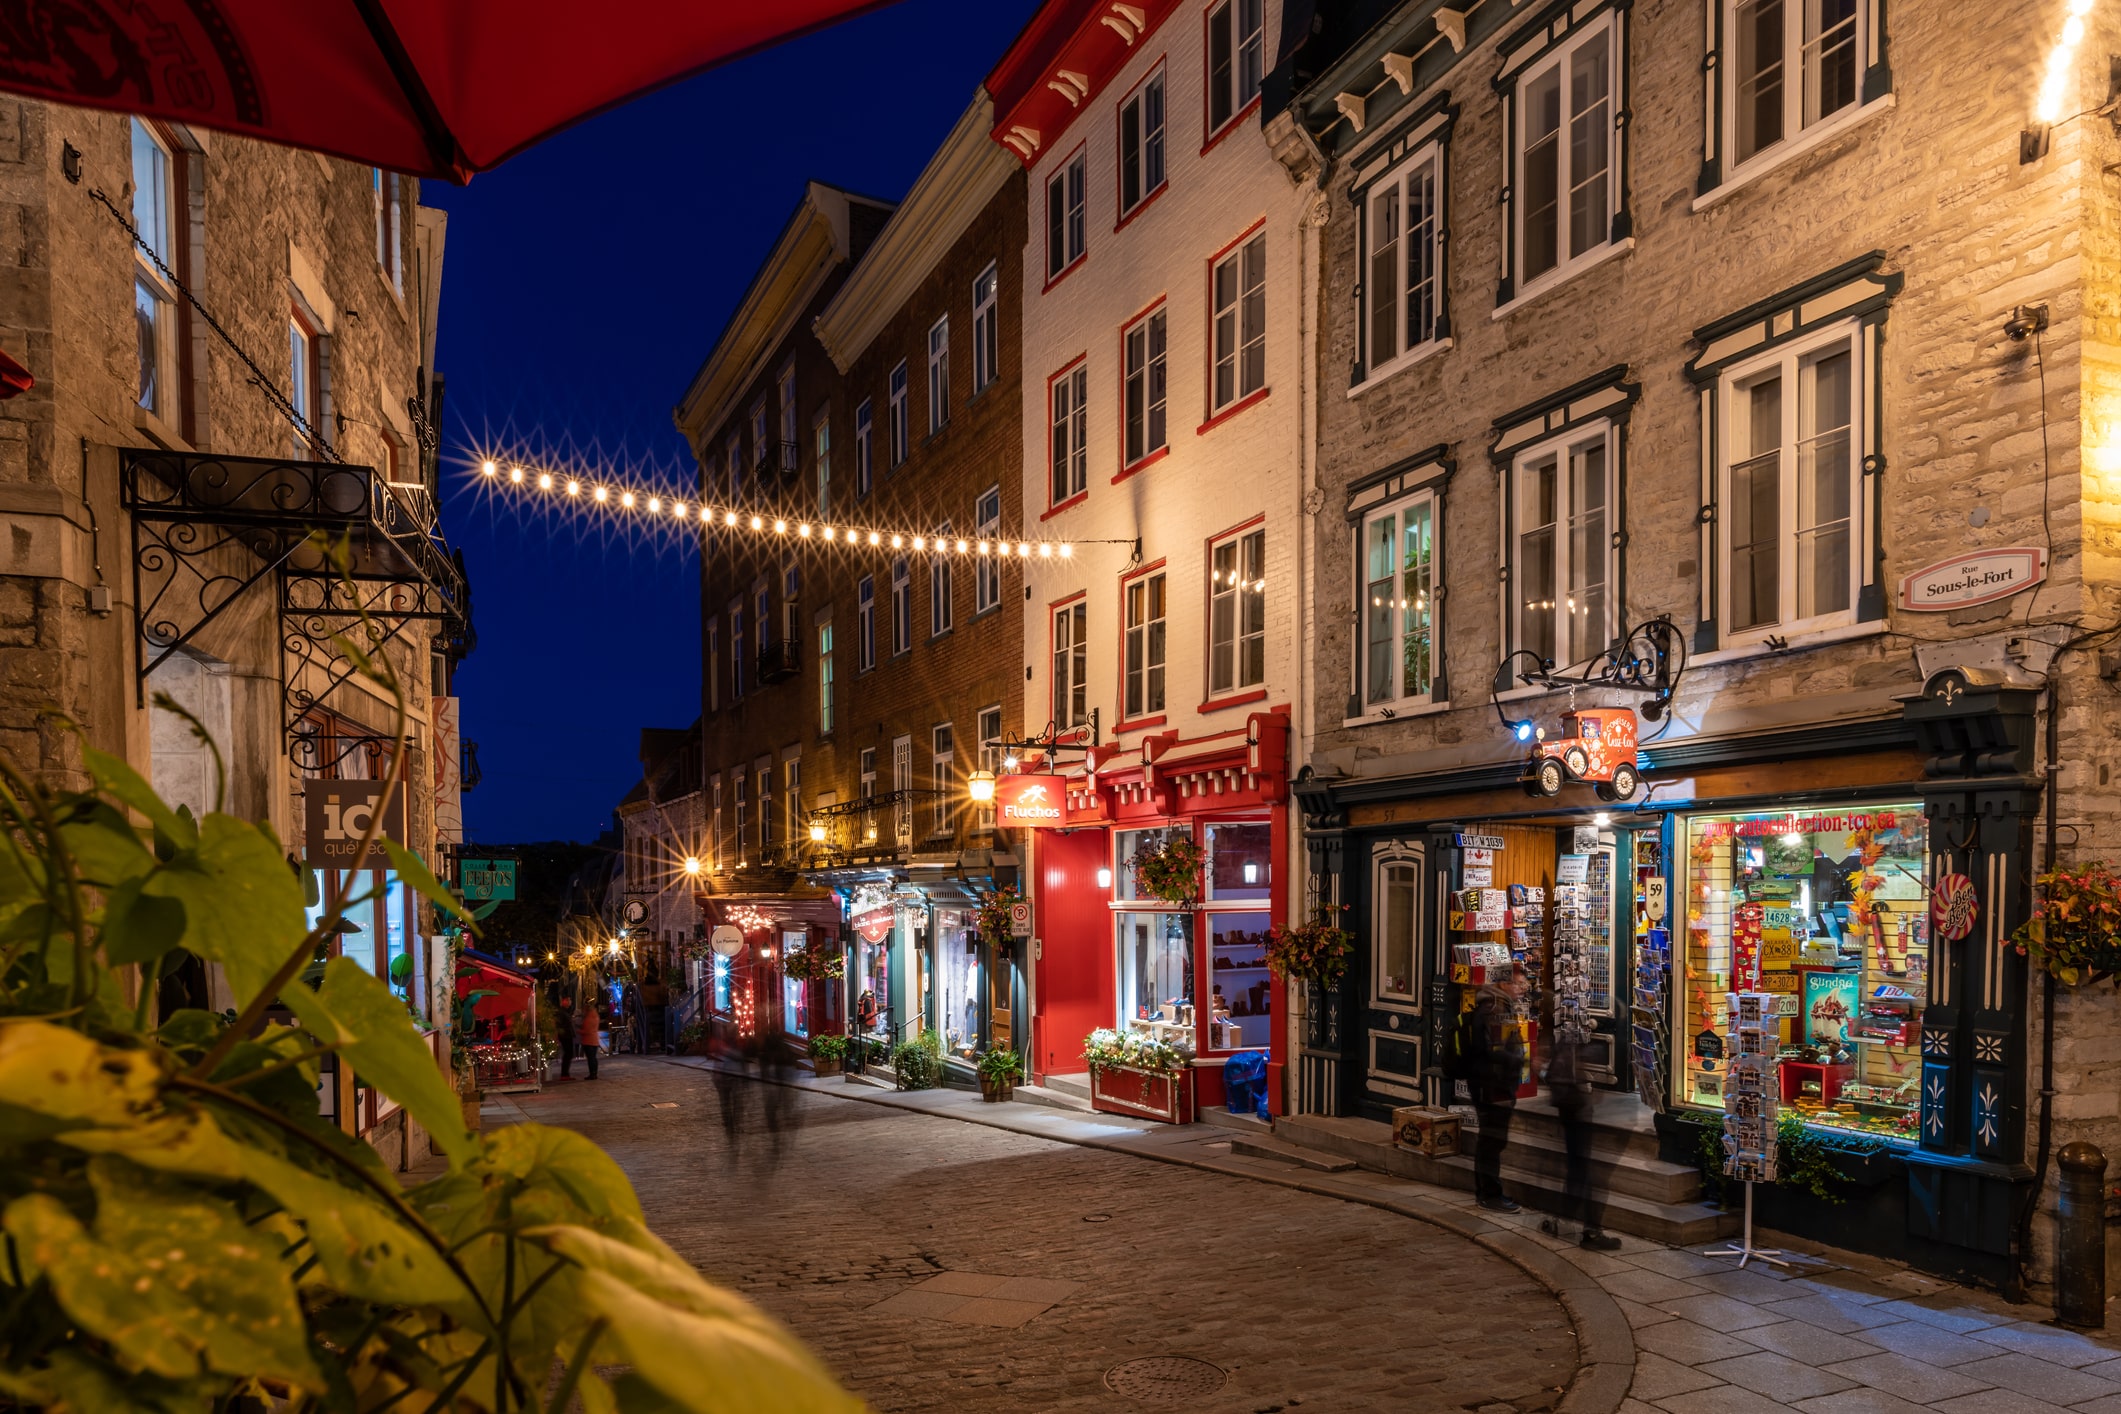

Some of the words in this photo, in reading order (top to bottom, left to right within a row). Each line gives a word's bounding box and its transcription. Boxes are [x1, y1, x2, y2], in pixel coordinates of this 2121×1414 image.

[1961, 566, 1979, 574] Rue
[1926, 568, 2014, 597] Sous-le-Fort
[323, 794, 387, 840] id
[1004, 804, 1060, 818] Fluchos
[1704, 811, 1896, 838] www.autocollection-tcc.ca
[324, 840, 387, 858] quéec
[1486, 837, 1504, 848] 1039
[1650, 884, 1662, 896] 59
[1766, 912, 1790, 923] 14628
[1780, 944, 1796, 956] 881
[1810, 976, 1854, 990] Sundae
